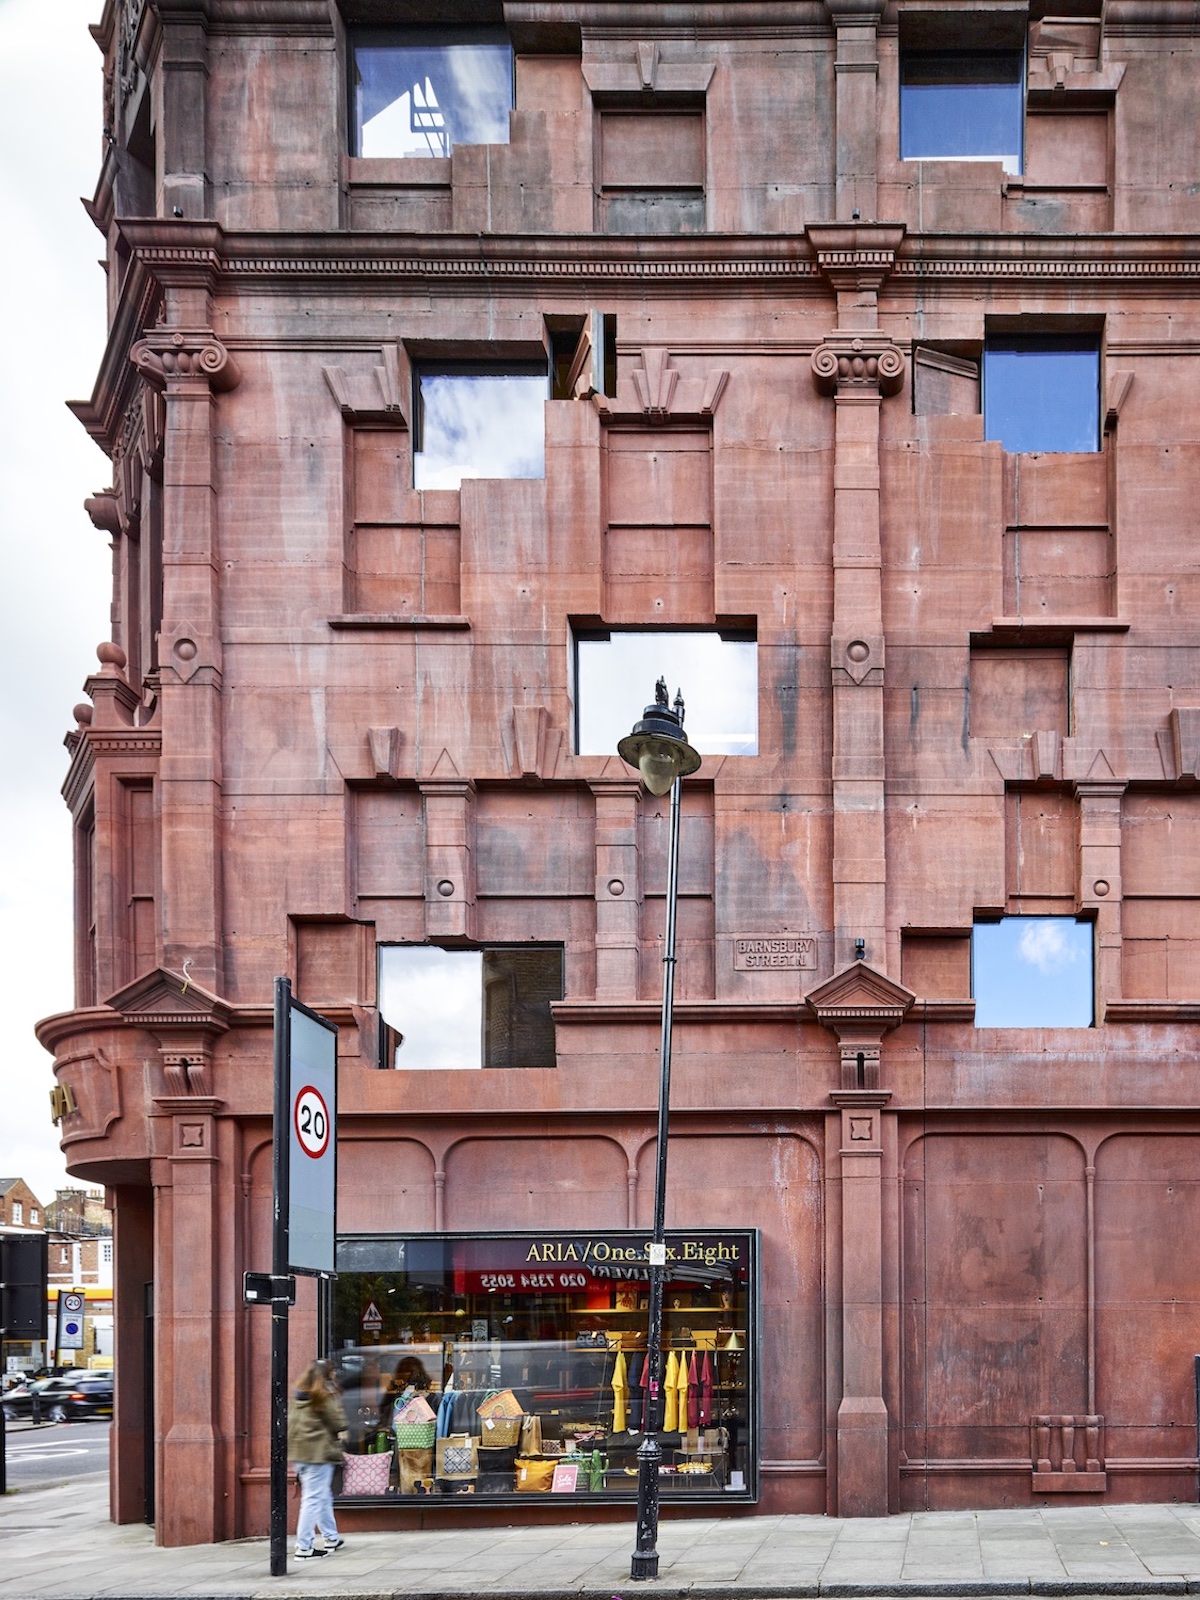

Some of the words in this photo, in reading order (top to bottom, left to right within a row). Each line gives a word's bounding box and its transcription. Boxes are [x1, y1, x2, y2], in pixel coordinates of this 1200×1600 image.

[739, 941, 811, 953] BARNSBURY
[301, 1105, 325, 1140] 20
[525, 1241, 739, 1265] ARIA/One.Sx.Eight
[67, 1299, 80, 1307] 20
